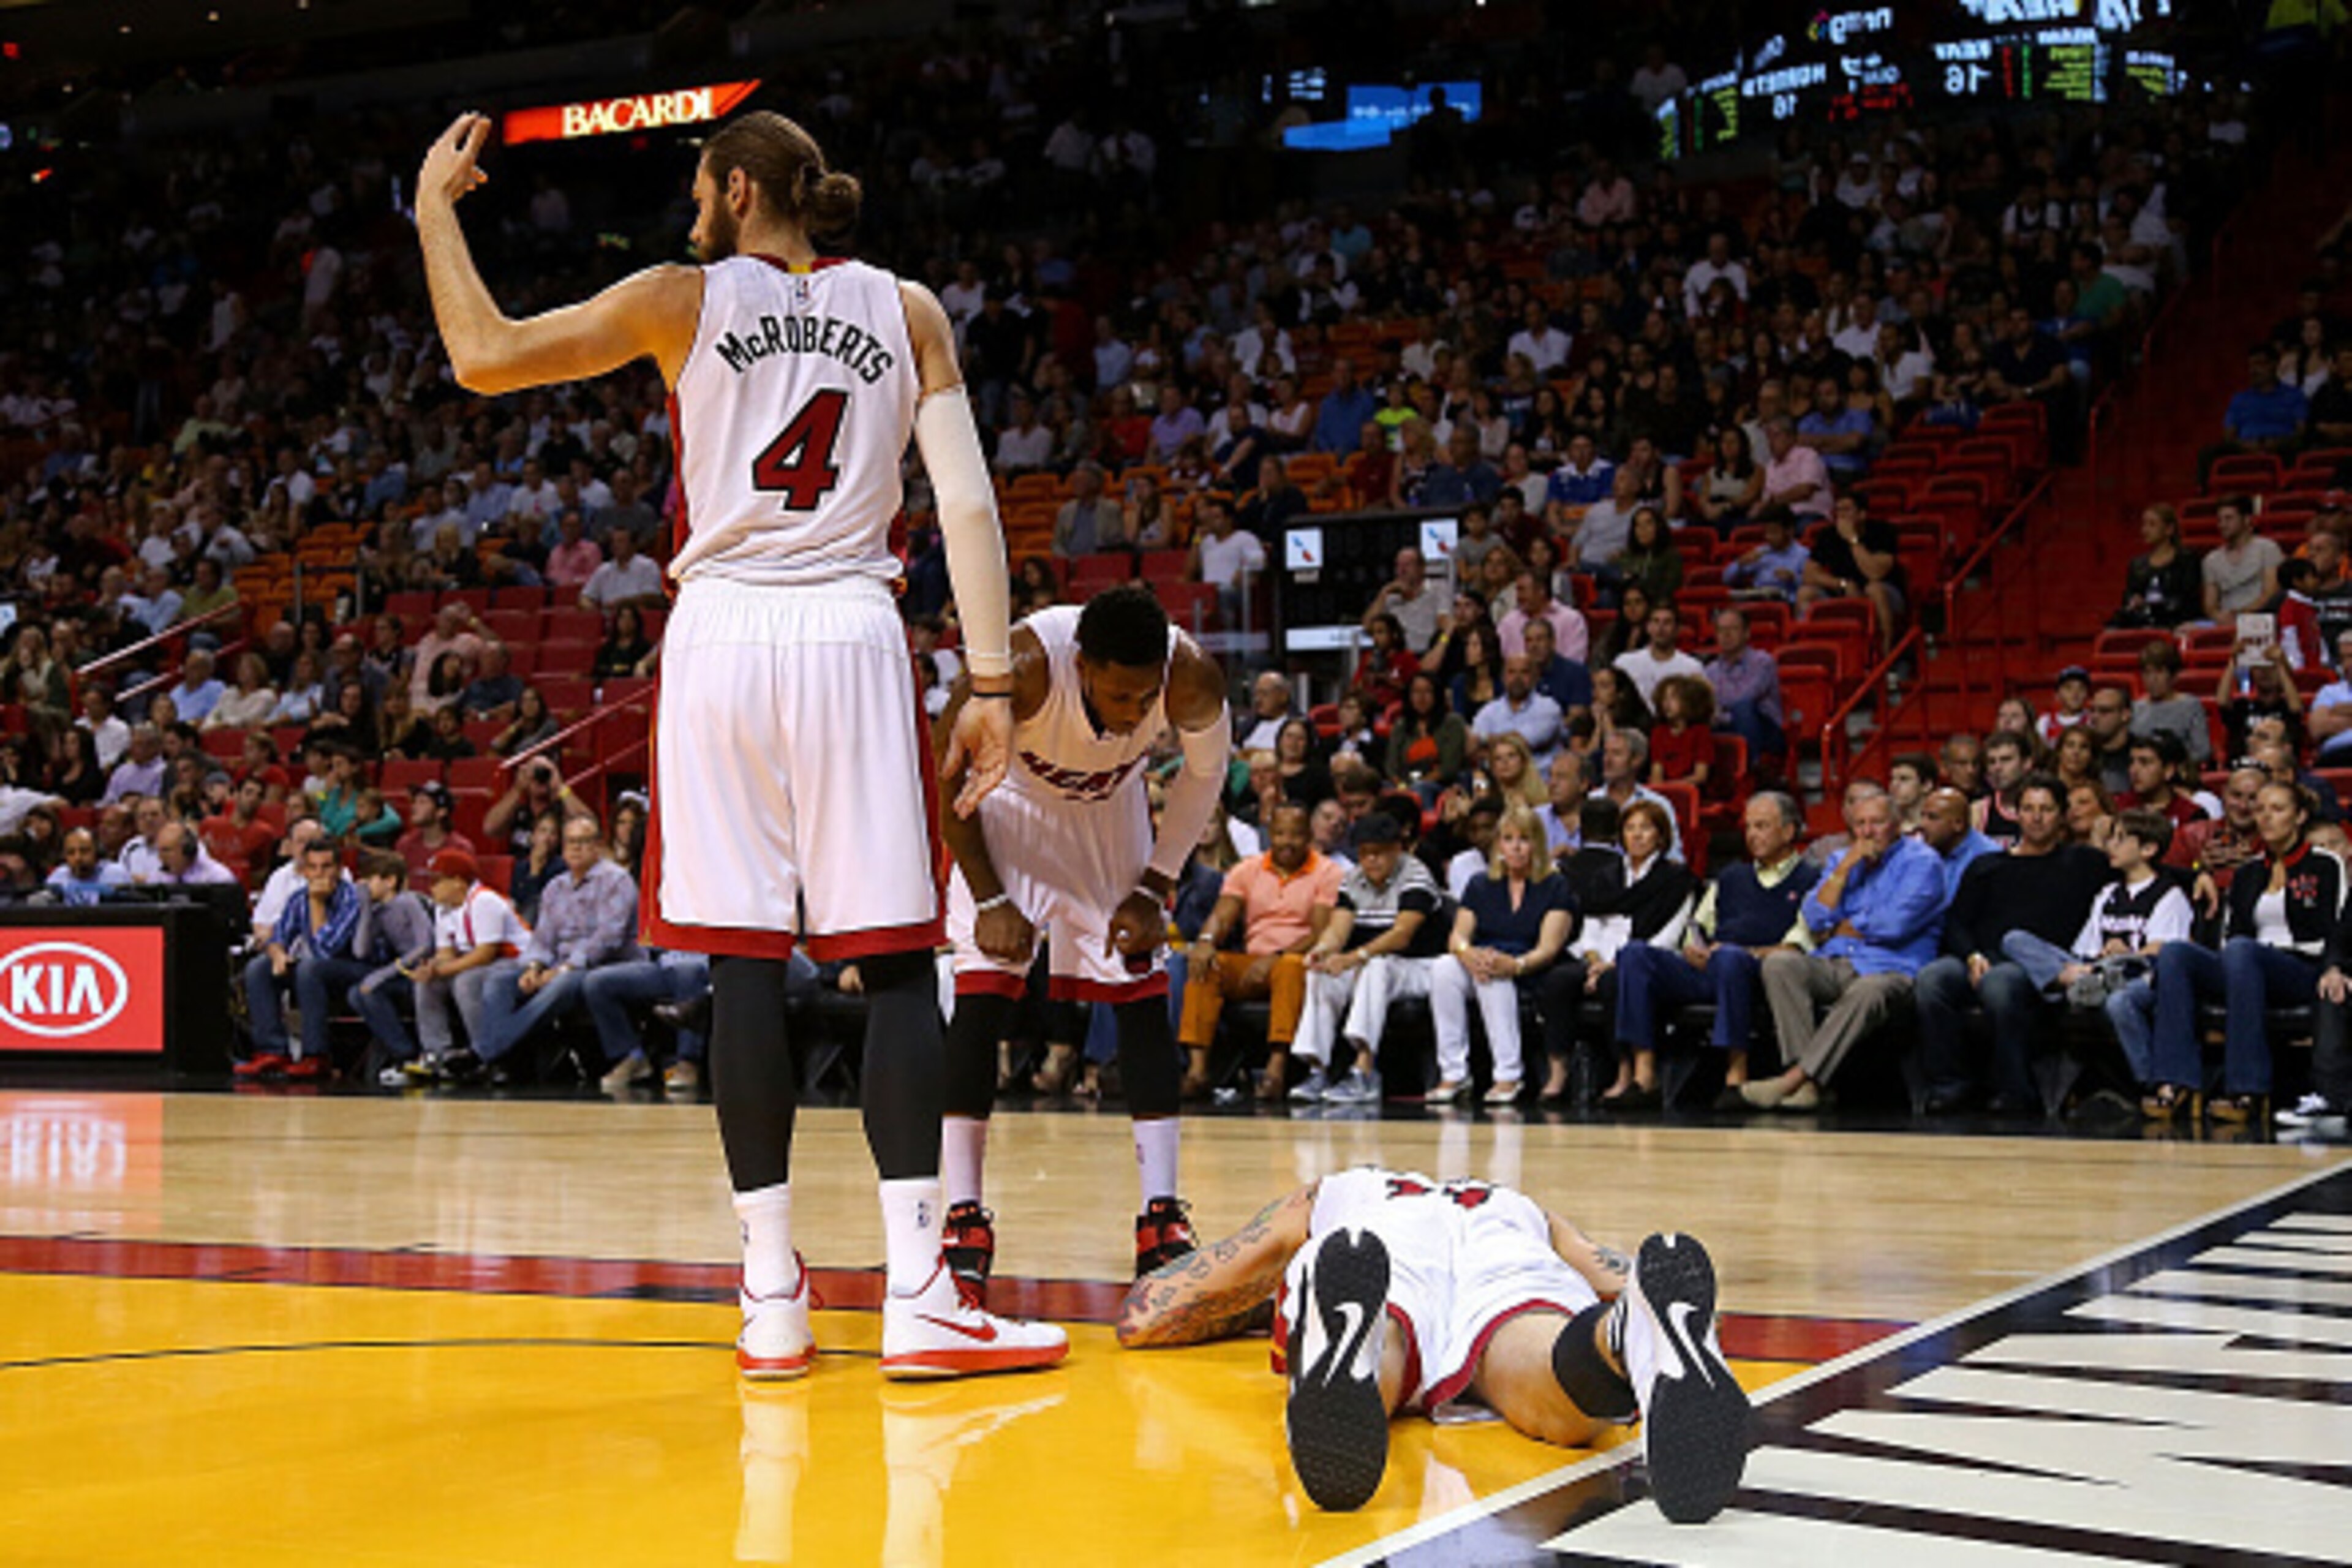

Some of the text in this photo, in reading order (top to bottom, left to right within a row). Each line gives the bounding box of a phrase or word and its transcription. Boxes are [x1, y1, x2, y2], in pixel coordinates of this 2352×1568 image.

[562, 87, 716, 138] BACARDI
[715, 315, 894, 385] McROBERTS
[752, 387, 850, 511] 4
[11, 964, 104, 1015] KIA
